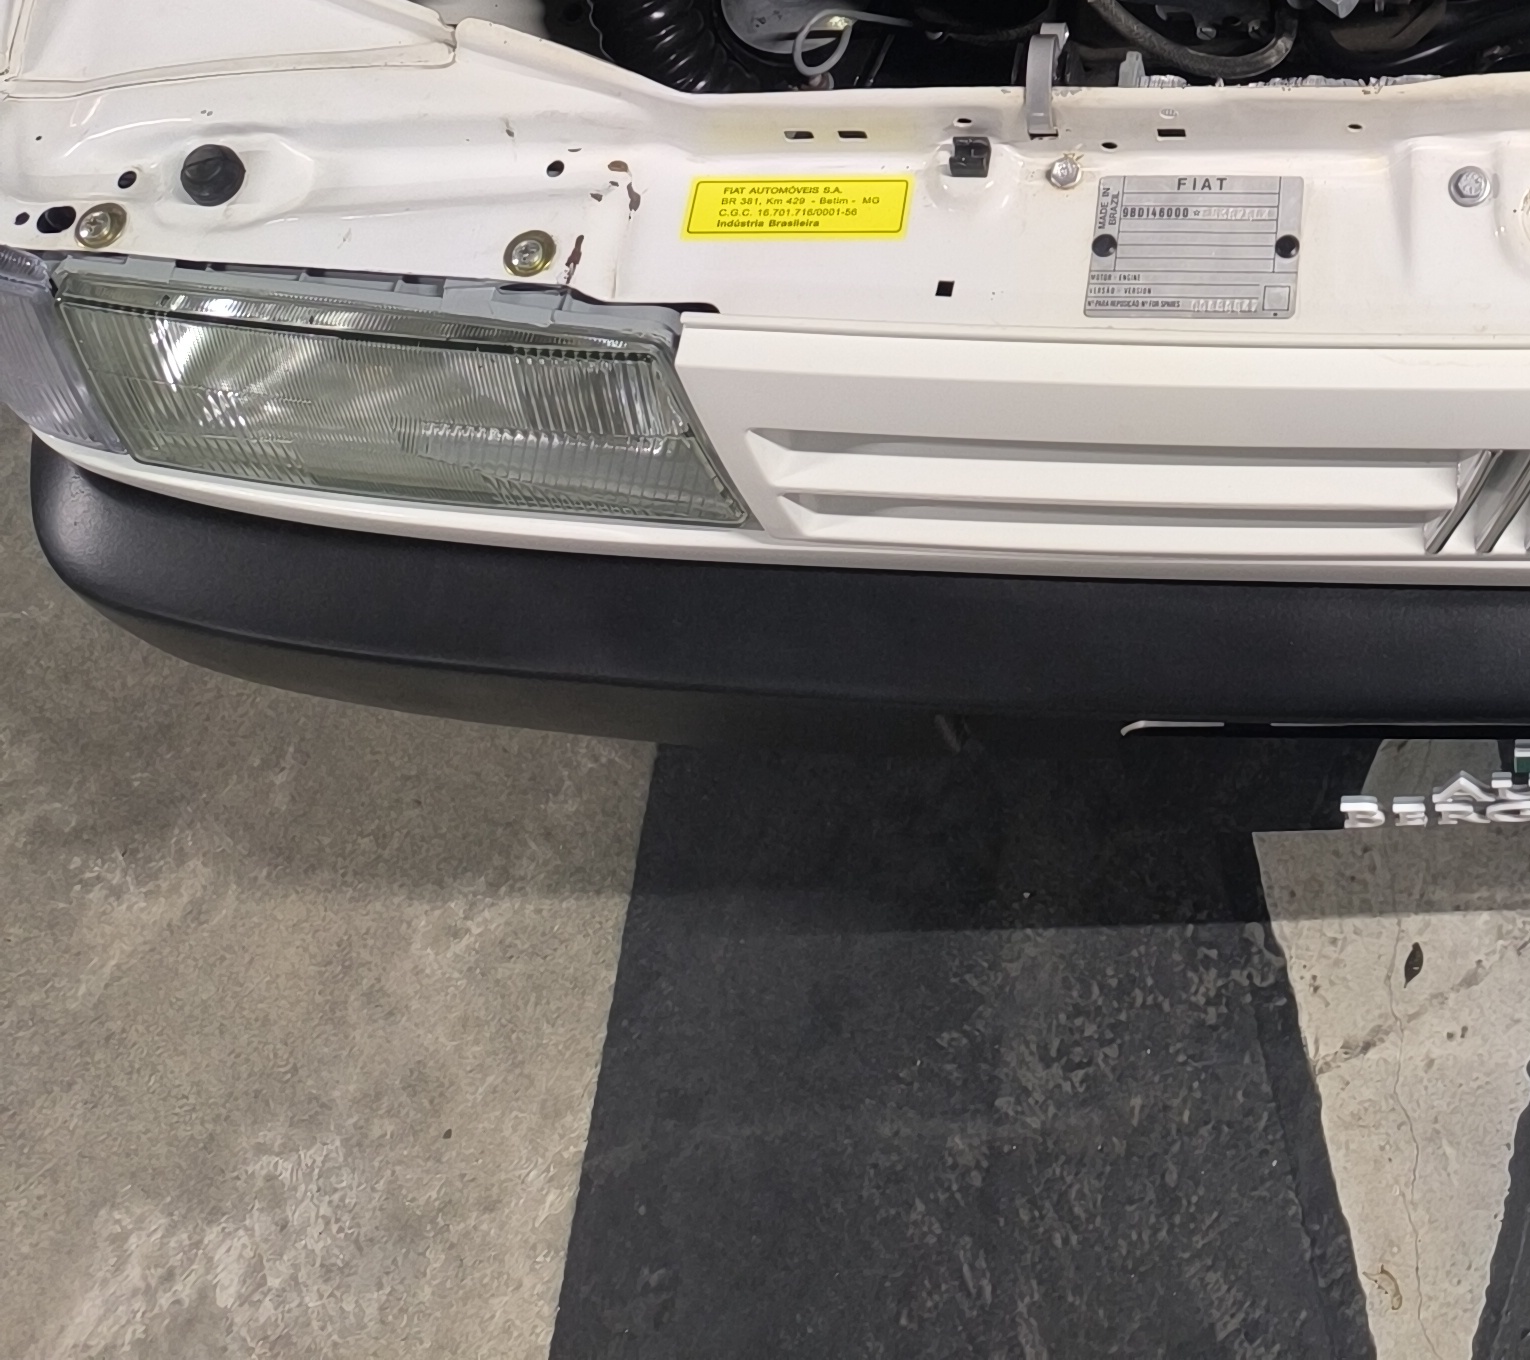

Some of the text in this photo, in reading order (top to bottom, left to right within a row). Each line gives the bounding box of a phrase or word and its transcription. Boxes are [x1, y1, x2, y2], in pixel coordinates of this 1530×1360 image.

[1177, 177, 1228, 191] FIAT
[723, 185, 843, 195] FIAT AUTOMÓVEIS S.A.
[721, 197, 737, 205] BR
[766, 197, 783, 205] Km
[820, 196, 849, 205] Betim
[862, 196, 880, 204] MG
[718, 208, 753, 217] C.G.C.
[1097, 187, 1111, 230] MADE IN
[1107, 190, 1120, 226] BRAZIL
[716, 218, 820, 228] Indústria Brasileira
[1118, 273, 1141, 281] ENGINE
[1123, 287, 1152, 295] VERSION
